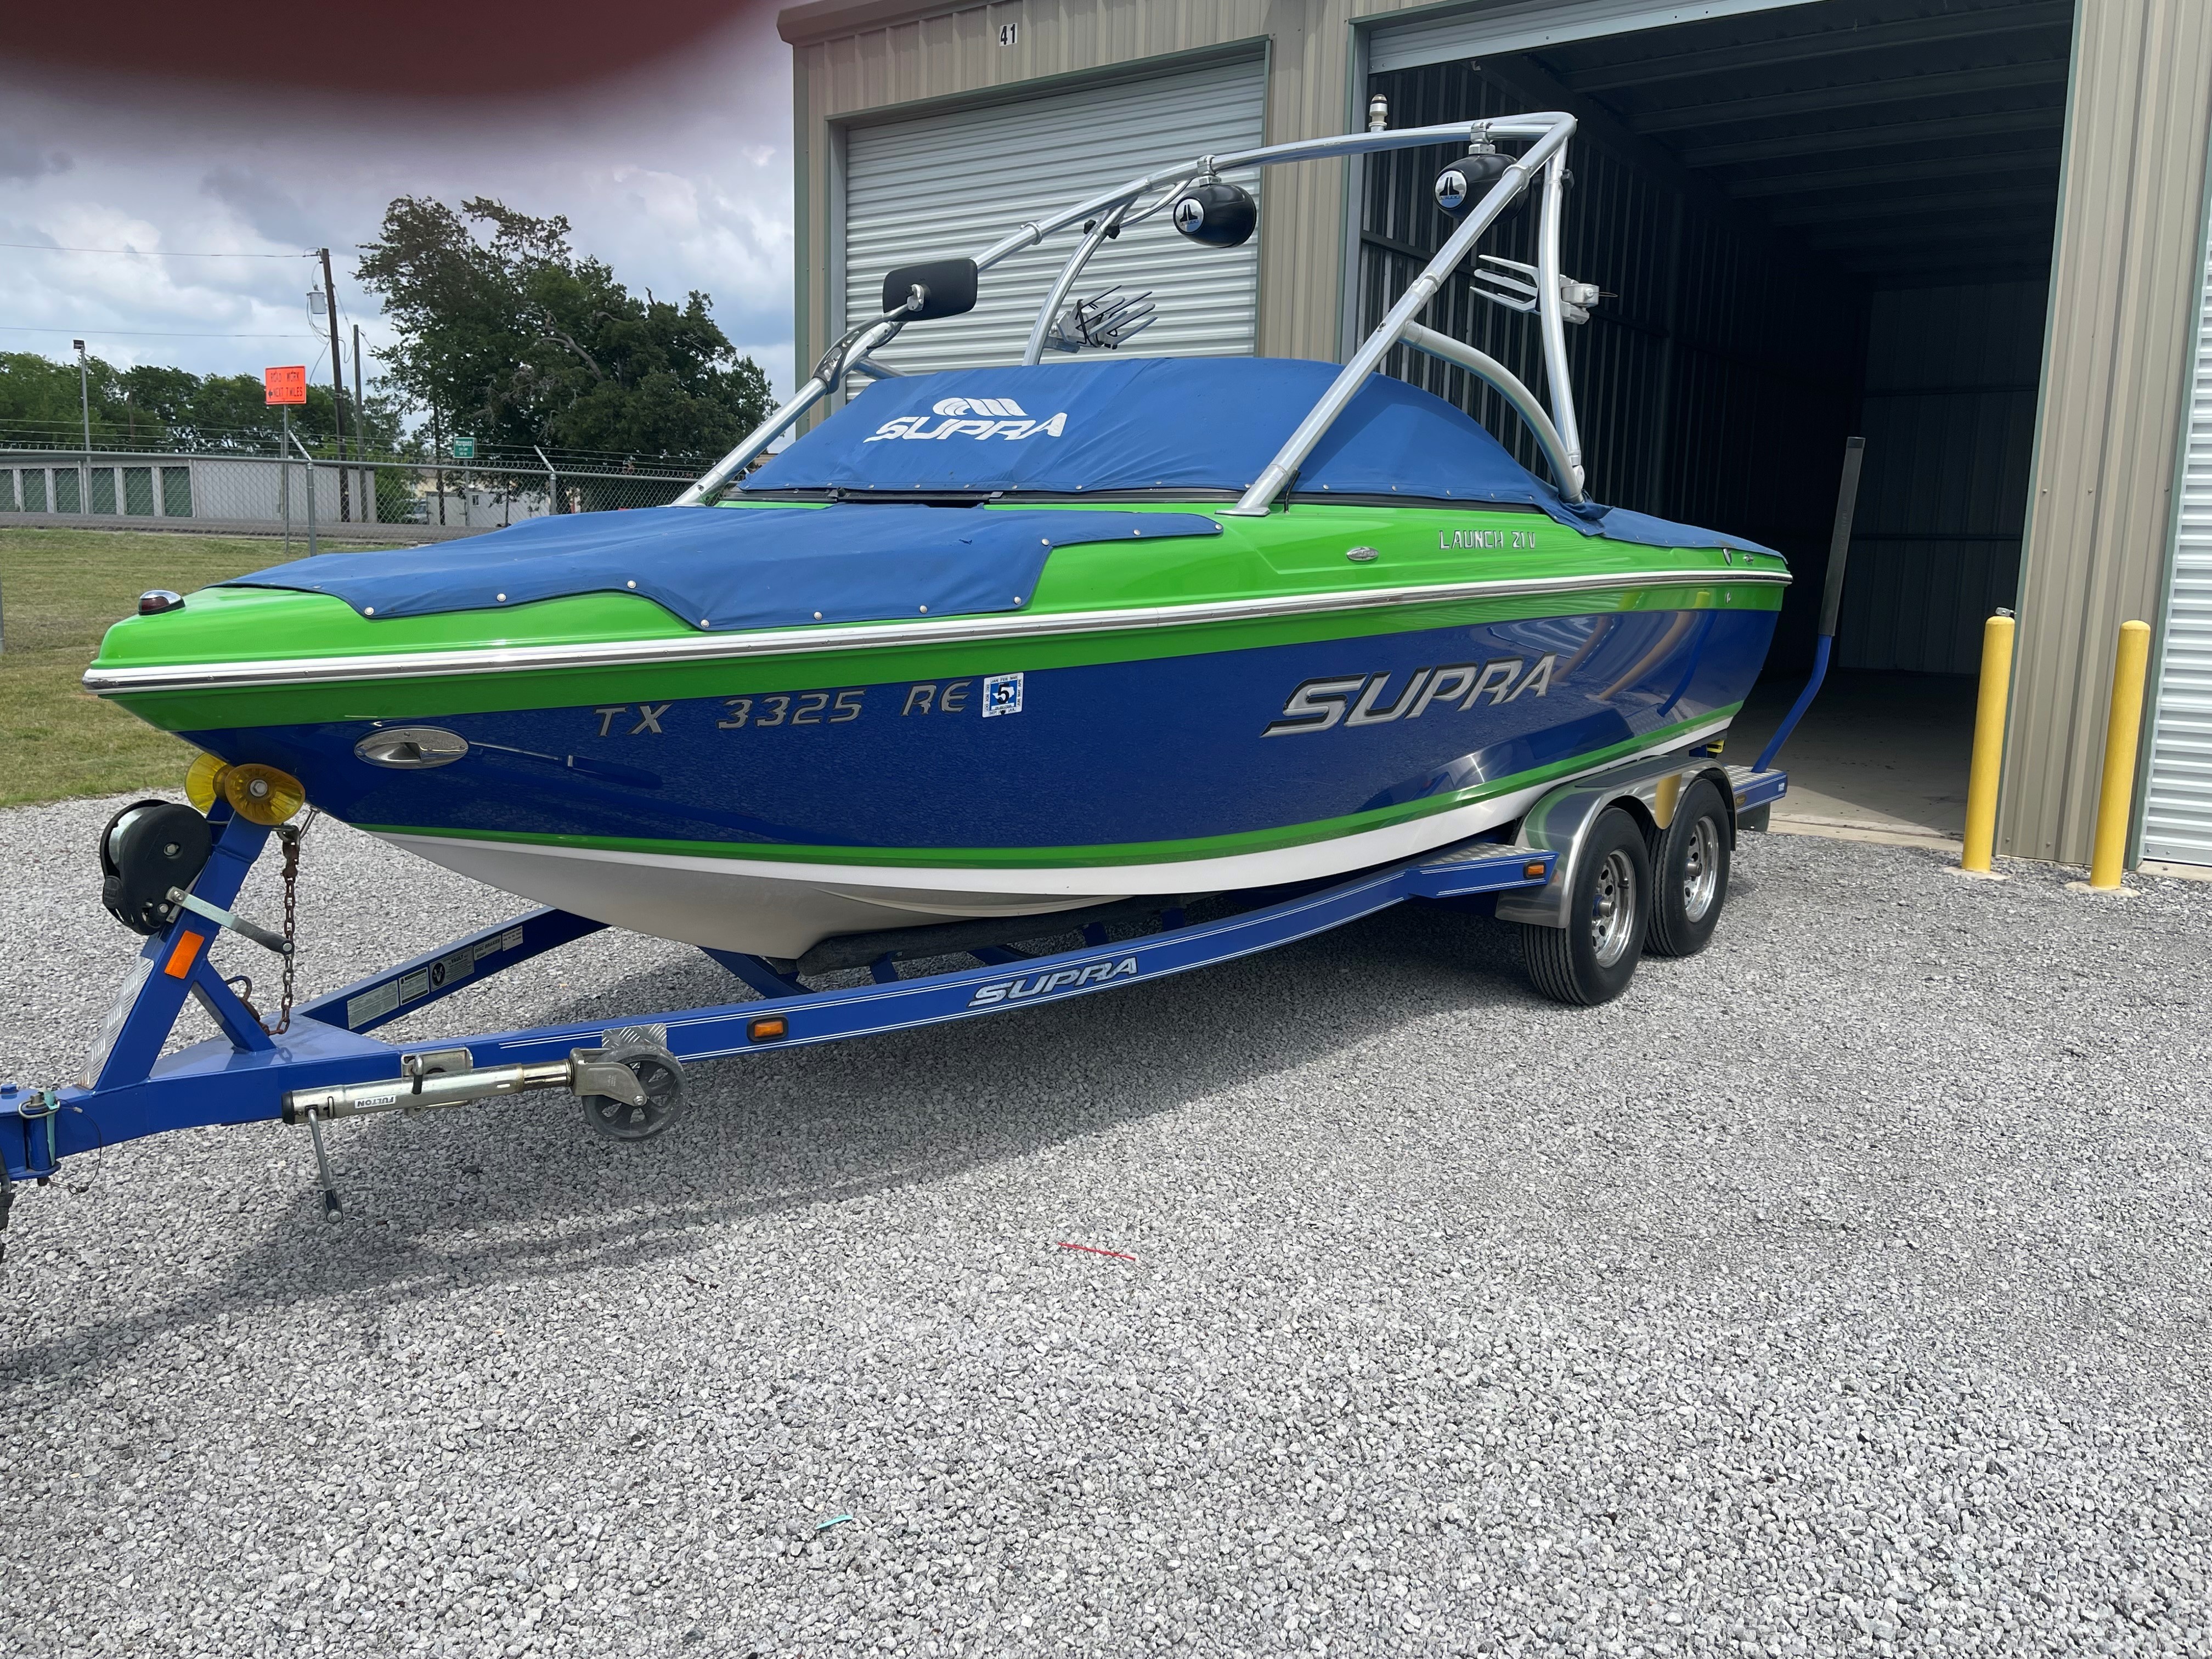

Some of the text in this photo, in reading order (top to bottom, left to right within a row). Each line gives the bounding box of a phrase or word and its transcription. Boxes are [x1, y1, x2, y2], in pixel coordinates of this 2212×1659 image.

[1000, 24, 1015, 45] 41
[270, 372, 300, 382] ROAD WORK
[273, 387, 284, 397] NEXT
[290, 386, 303, 397] MILES
[863, 412, 1068, 443] SUPRA
[1438, 530, 1504, 550] LAUNCH
[997, 683, 1009, 704] 5
[1260, 651, 1558, 738] SUPRA
[594, 679, 973, 737] TX 3325 RE
[967, 956, 1138, 1007] SUPRA
[357, 1096, 394, 1107] FULTON
